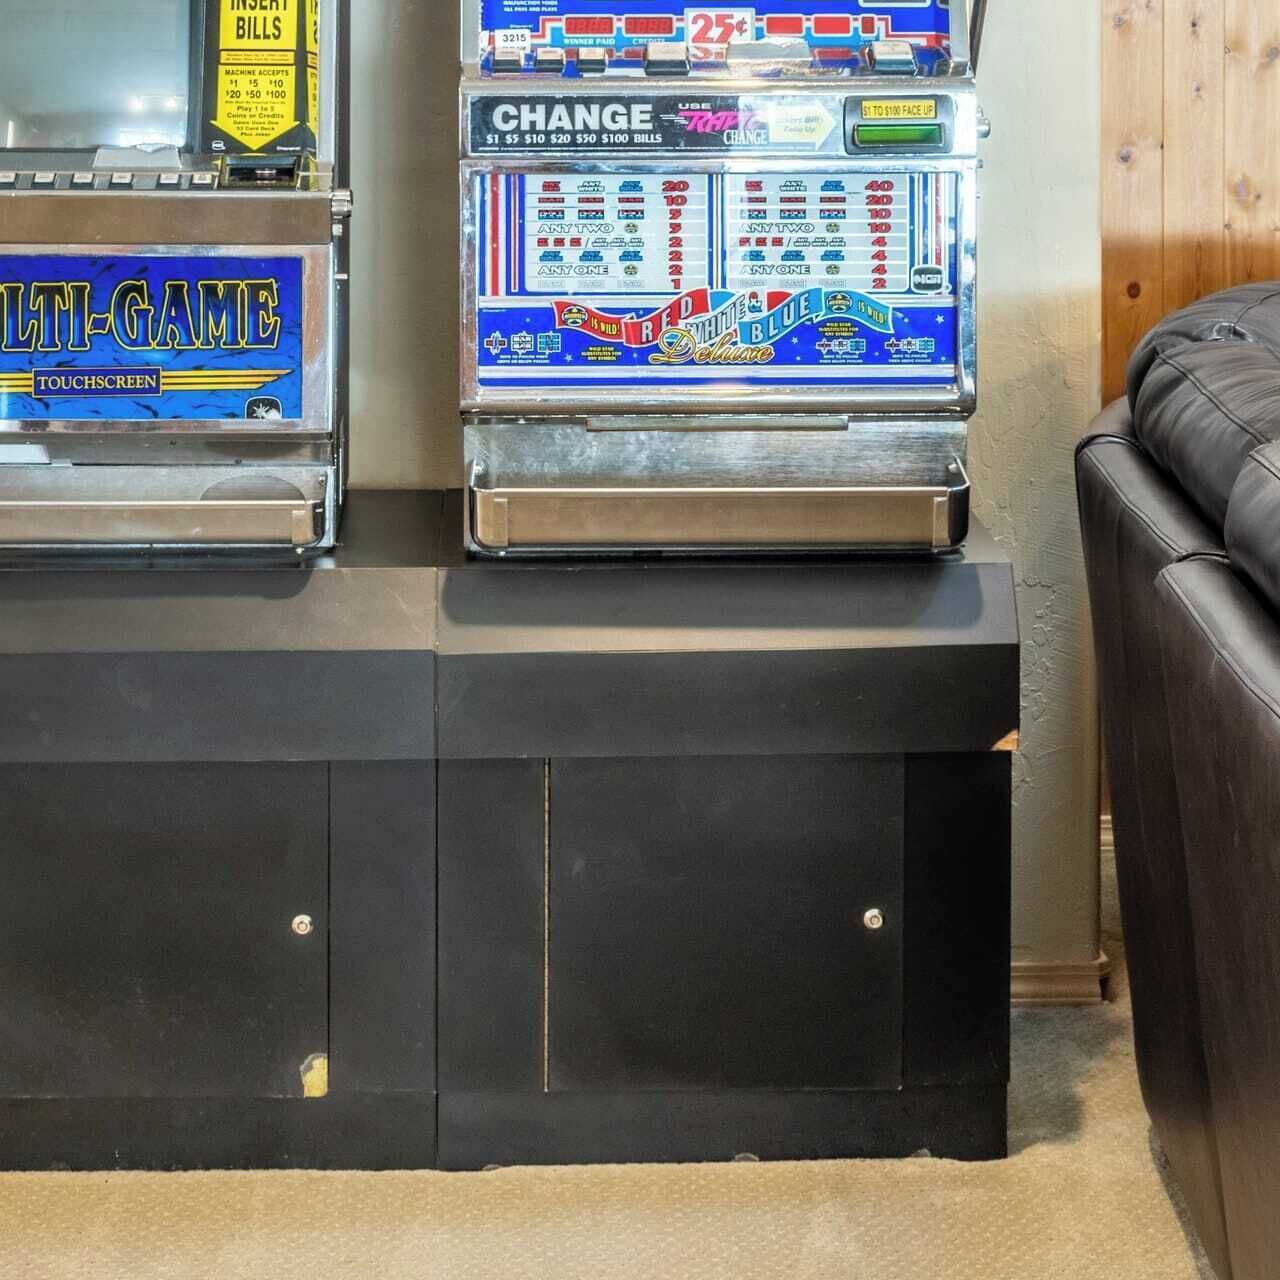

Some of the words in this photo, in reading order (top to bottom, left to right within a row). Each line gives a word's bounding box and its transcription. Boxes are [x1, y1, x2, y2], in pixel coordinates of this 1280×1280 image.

[235, 16, 282, 40] BILLS
[502, 33, 528, 42] 3215
[258, 69, 289, 77] ACCEPTS
[863, 104, 871, 117] $1
[873, 104, 884, 117] TO
[885, 104, 901, 116] $100
[902, 103, 922, 116] FACE
[923, 103, 934, 116] UP
[492, 103, 654, 131] CHANGE
[486, 133, 499, 144] $1
[505, 133, 519, 144] $5
[524, 133, 545, 144] $10
[550, 133, 571, 144] $20
[576, 133, 597, 144] $50
[601, 133, 629, 144] $100
[633, 133, 663, 144] BILLS
[723, 129, 769, 145] CHANGE
[662, 180, 690, 192] 20
[864, 180, 895, 192] 40
[663, 195, 688, 207] 10
[865, 194, 894, 206] 20
[537, 222, 572, 234] ANY
[573, 222, 616, 234] TWO
[739, 222, 774, 234] ANY
[775, 222, 816, 234] TWO
[667, 236, 684, 248] 2
[870, 236, 888, 248] 4
[667, 250, 684, 262] 2
[870, 250, 888, 262] 4
[537, 264, 573, 276] ANY
[573, 264, 610, 276] ONE
[667, 264, 684, 276] 2
[739, 264, 776, 276] ANY
[776, 264, 812, 276] ONE
[870, 264, 888, 276] 4
[871, 278, 888, 290] 2
[747, 291, 763, 313] &
[641, 295, 693, 343] RED
[683, 292, 746, 344] WHITE
[751, 291, 810, 344] BLUE
[600, 320, 621, 336] WILD!
[648, 327, 774, 364] Deluxe
[36, 373, 158, 391] TOUCHSCREEN
